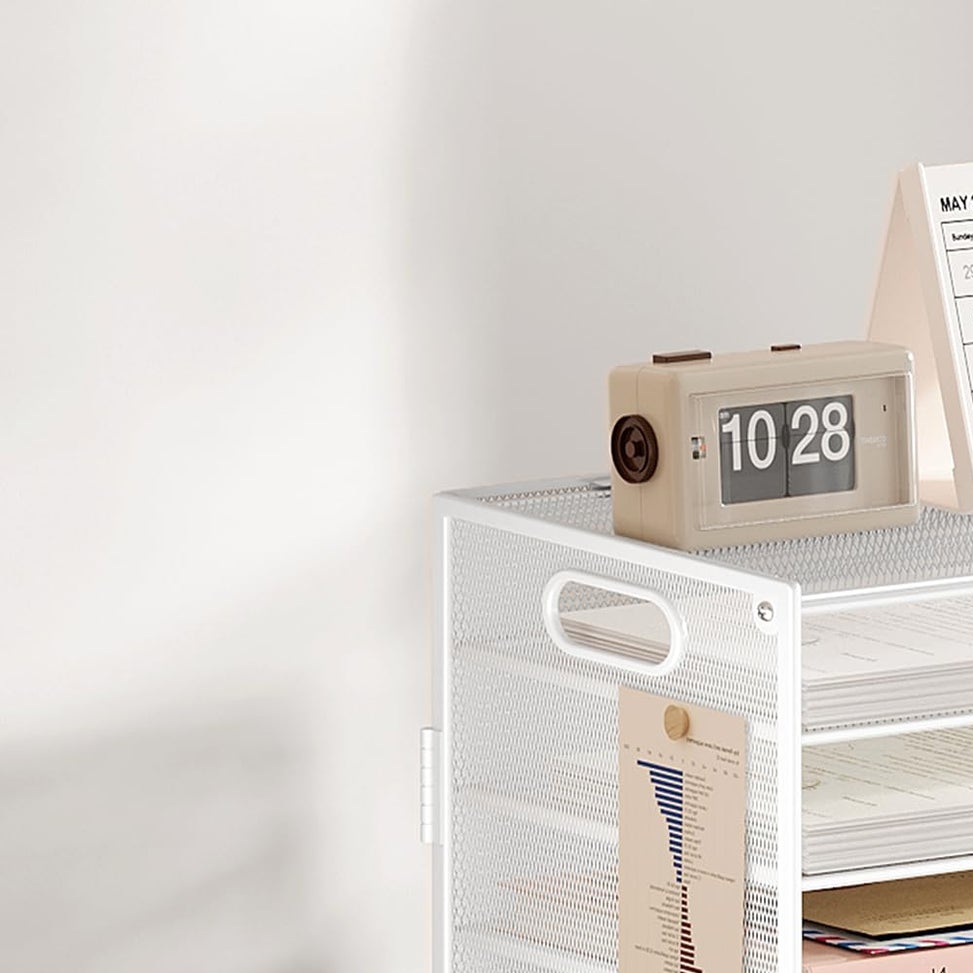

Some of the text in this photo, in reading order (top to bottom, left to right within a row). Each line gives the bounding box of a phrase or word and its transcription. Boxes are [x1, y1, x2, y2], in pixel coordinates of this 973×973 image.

[941, 193, 968, 212] MAY
[722, 402, 851, 471] 10 28
